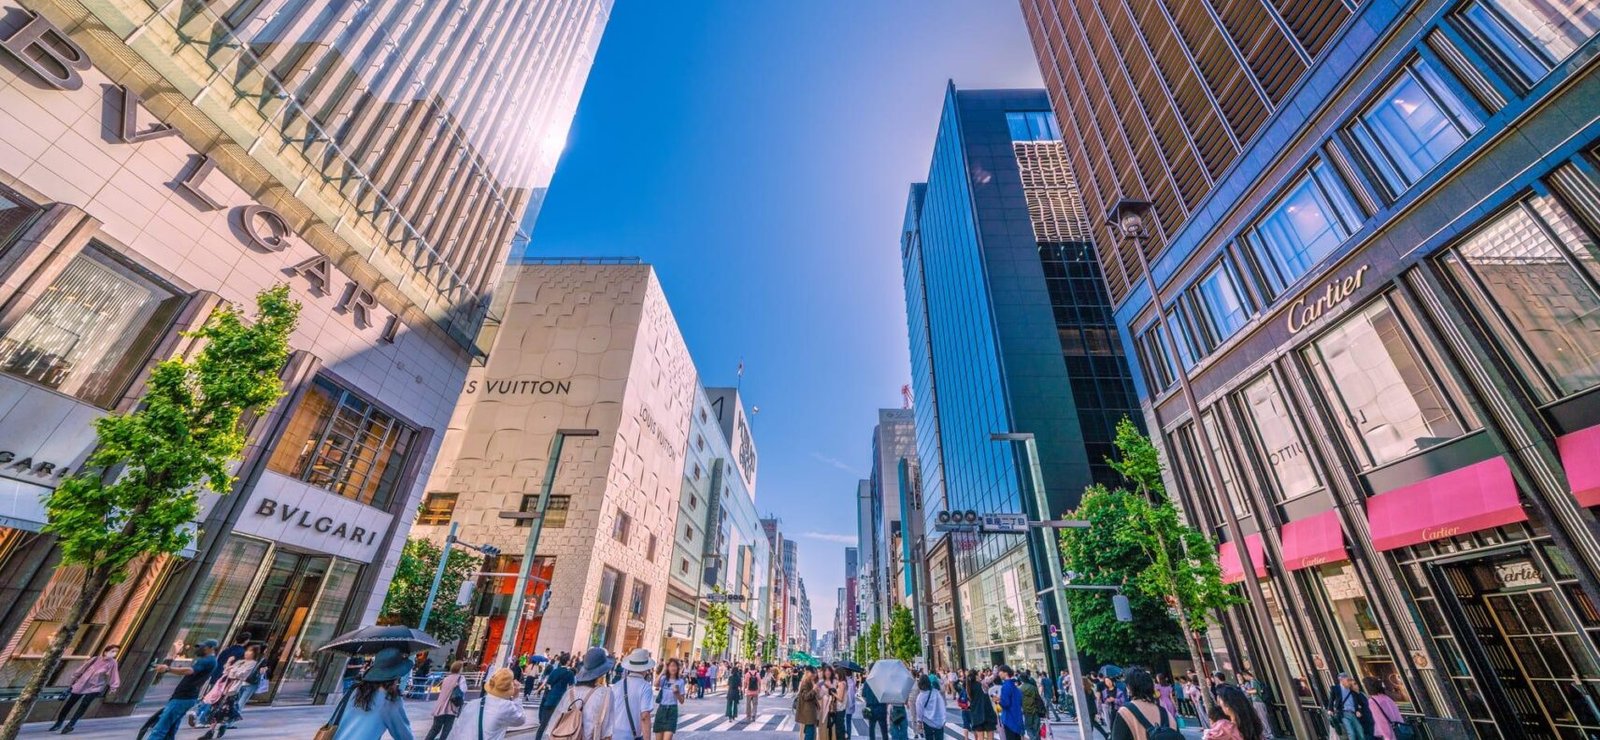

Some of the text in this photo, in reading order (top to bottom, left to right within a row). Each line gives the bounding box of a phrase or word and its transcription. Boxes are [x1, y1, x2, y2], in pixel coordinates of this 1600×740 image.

[0, 10, 399, 344] BVLGARI
[1287, 264, 1370, 333] Cartier
[487, 380, 571, 395] VUITTON
[640, 402, 675, 462] LOUIS VUITTON
[256, 498, 377, 545] BVLGARI
[1422, 527, 1460, 541] Cartier
